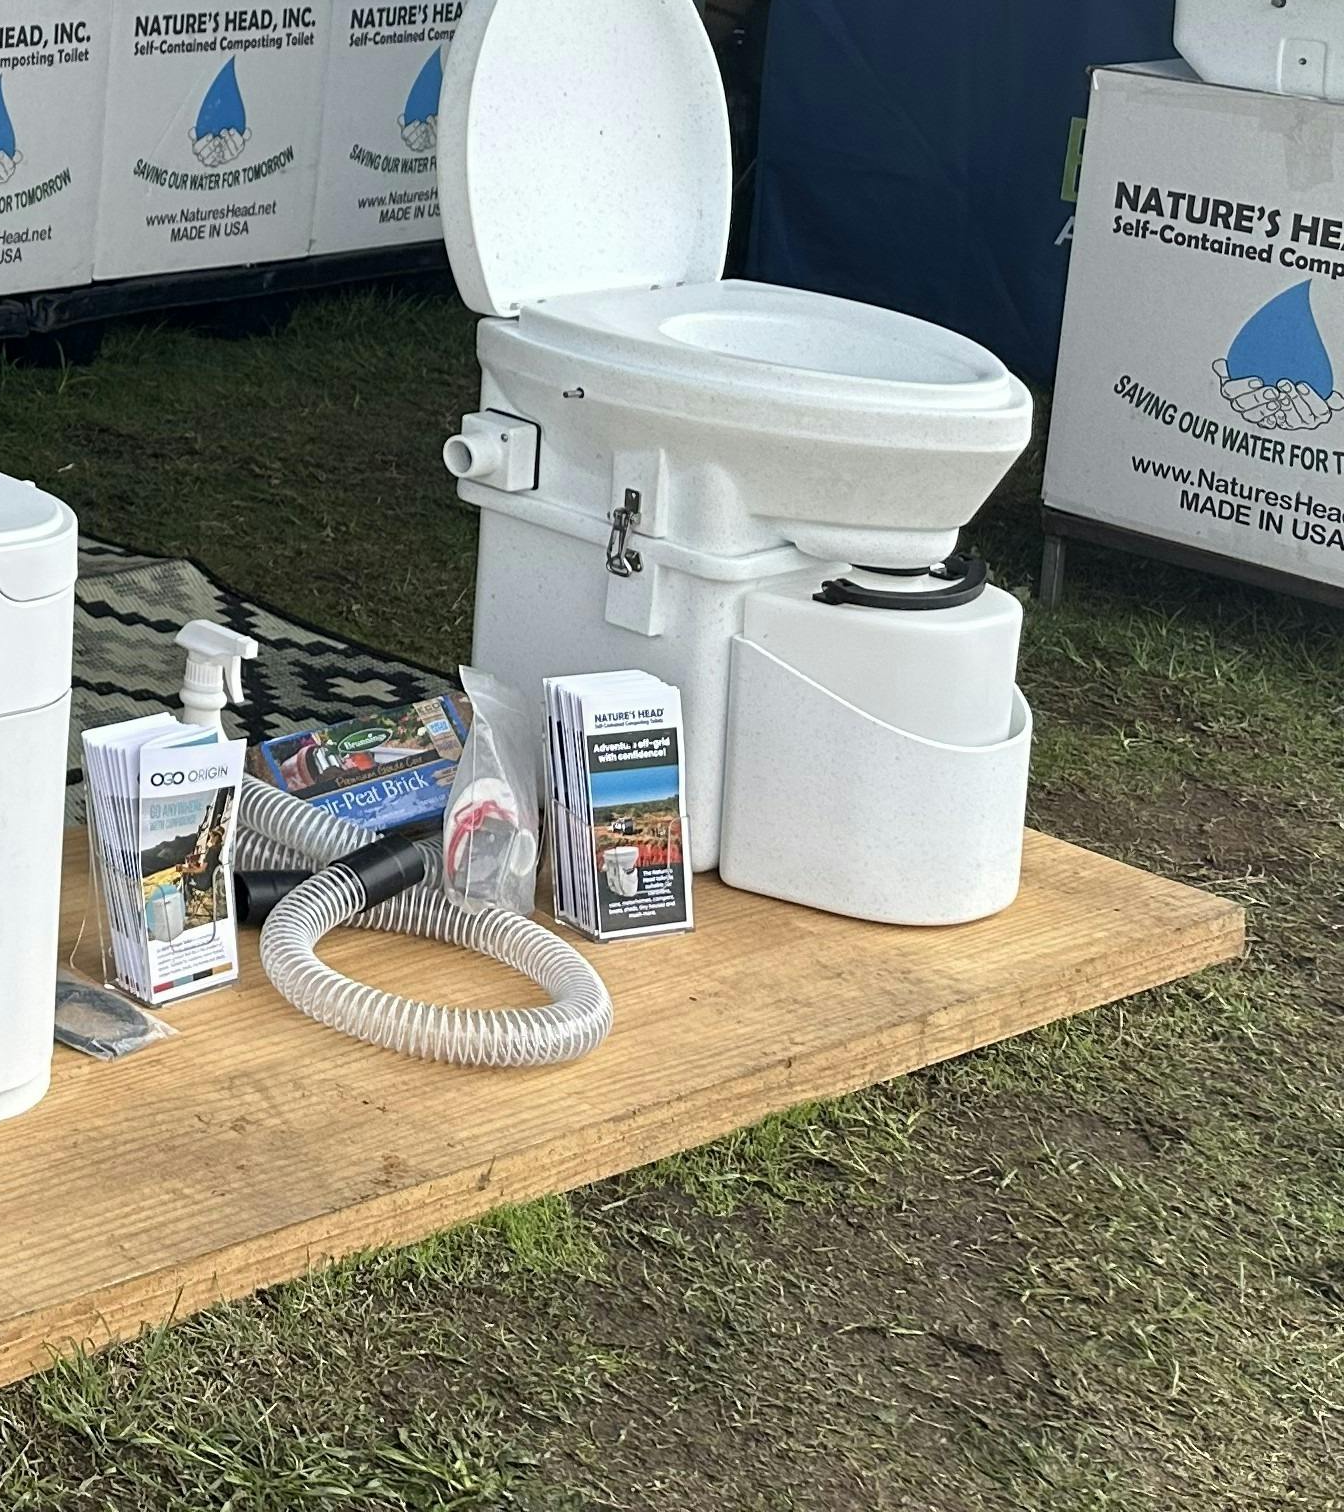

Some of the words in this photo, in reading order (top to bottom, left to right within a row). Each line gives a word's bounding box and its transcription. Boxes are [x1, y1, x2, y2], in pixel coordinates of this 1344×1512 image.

[54, 22, 90, 45] INC.
[58, 48, 89, 63] Toilet
[15, 168, 71, 209] TOMORROW
